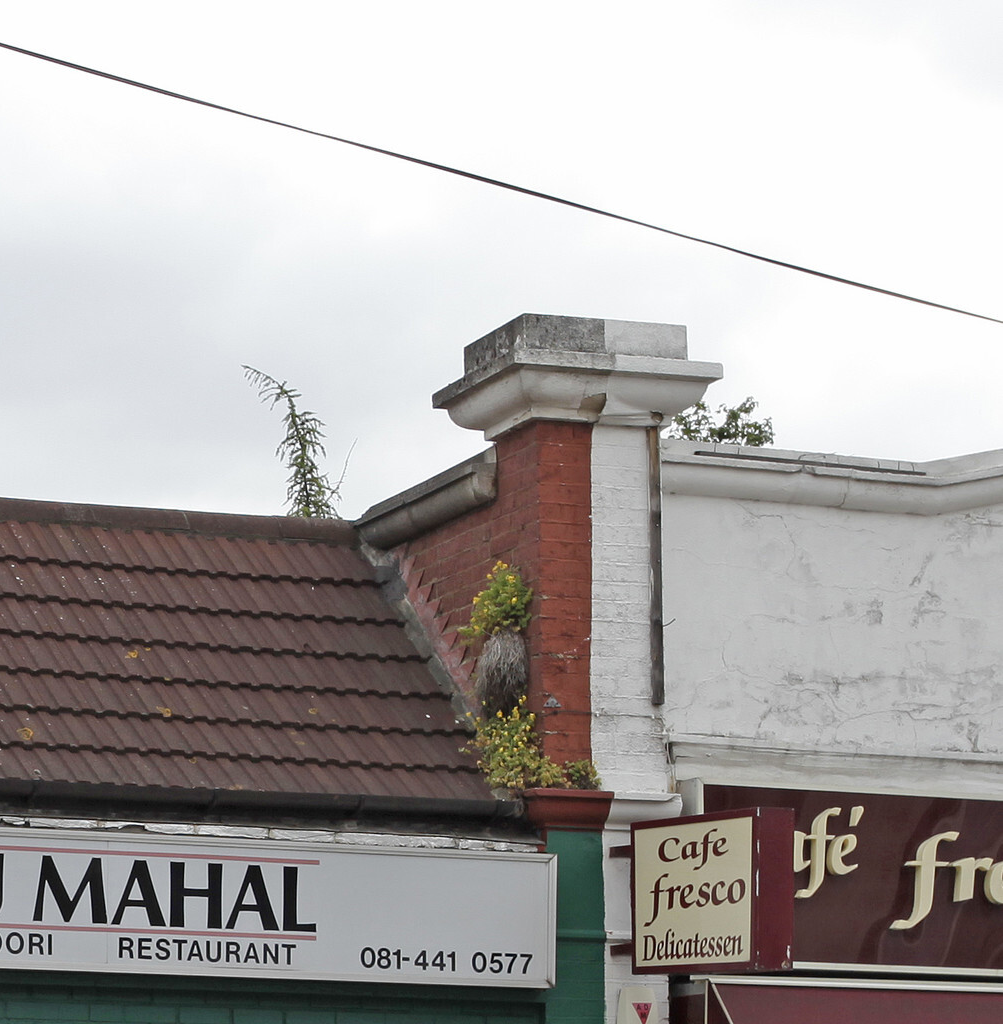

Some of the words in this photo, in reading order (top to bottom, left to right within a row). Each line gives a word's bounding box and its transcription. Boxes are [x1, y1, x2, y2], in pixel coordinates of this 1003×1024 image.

[657, 828, 729, 871] Cafe
[32, 854, 317, 933] MAHAL
[643, 873, 747, 927] fresco
[118, 936, 297, 966] RESTAURANT
[359, 946, 458, 973] 081-441
[471, 951, 534, 975] 0577
[641, 928, 744, 962] Delicatessen
